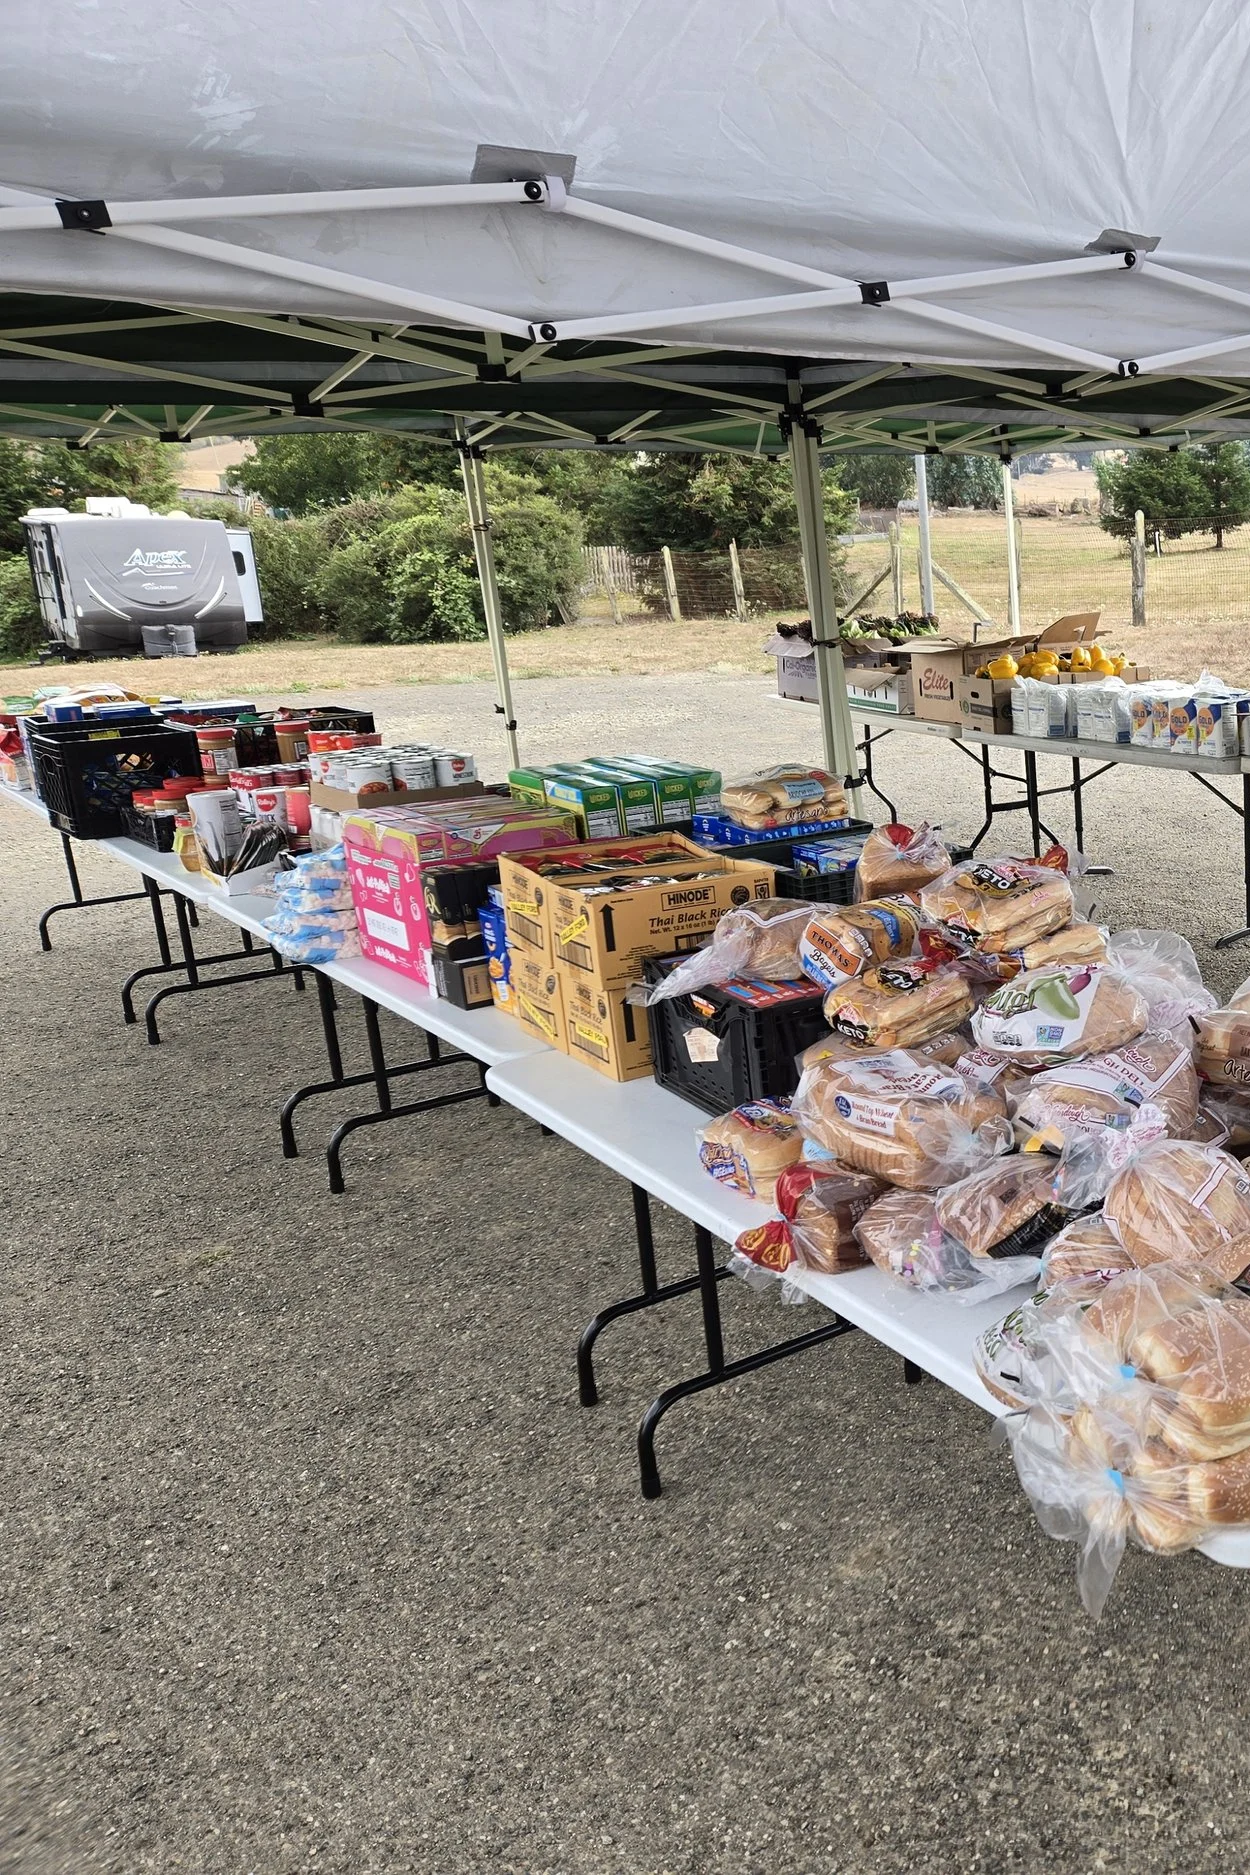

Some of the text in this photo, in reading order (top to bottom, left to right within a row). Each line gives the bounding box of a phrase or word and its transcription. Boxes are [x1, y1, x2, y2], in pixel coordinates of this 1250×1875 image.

[124, 548, 187, 566] Apex
[923, 667, 949, 690] Elite
[1171, 715, 1187, 724] GOLD
[667, 889, 710, 905] HINODE
[649, 914, 675, 928] Thai
[678, 911, 706, 924] Black
[799, 948, 837, 979] Bagels
[837, 1022, 865, 1041] KETO
